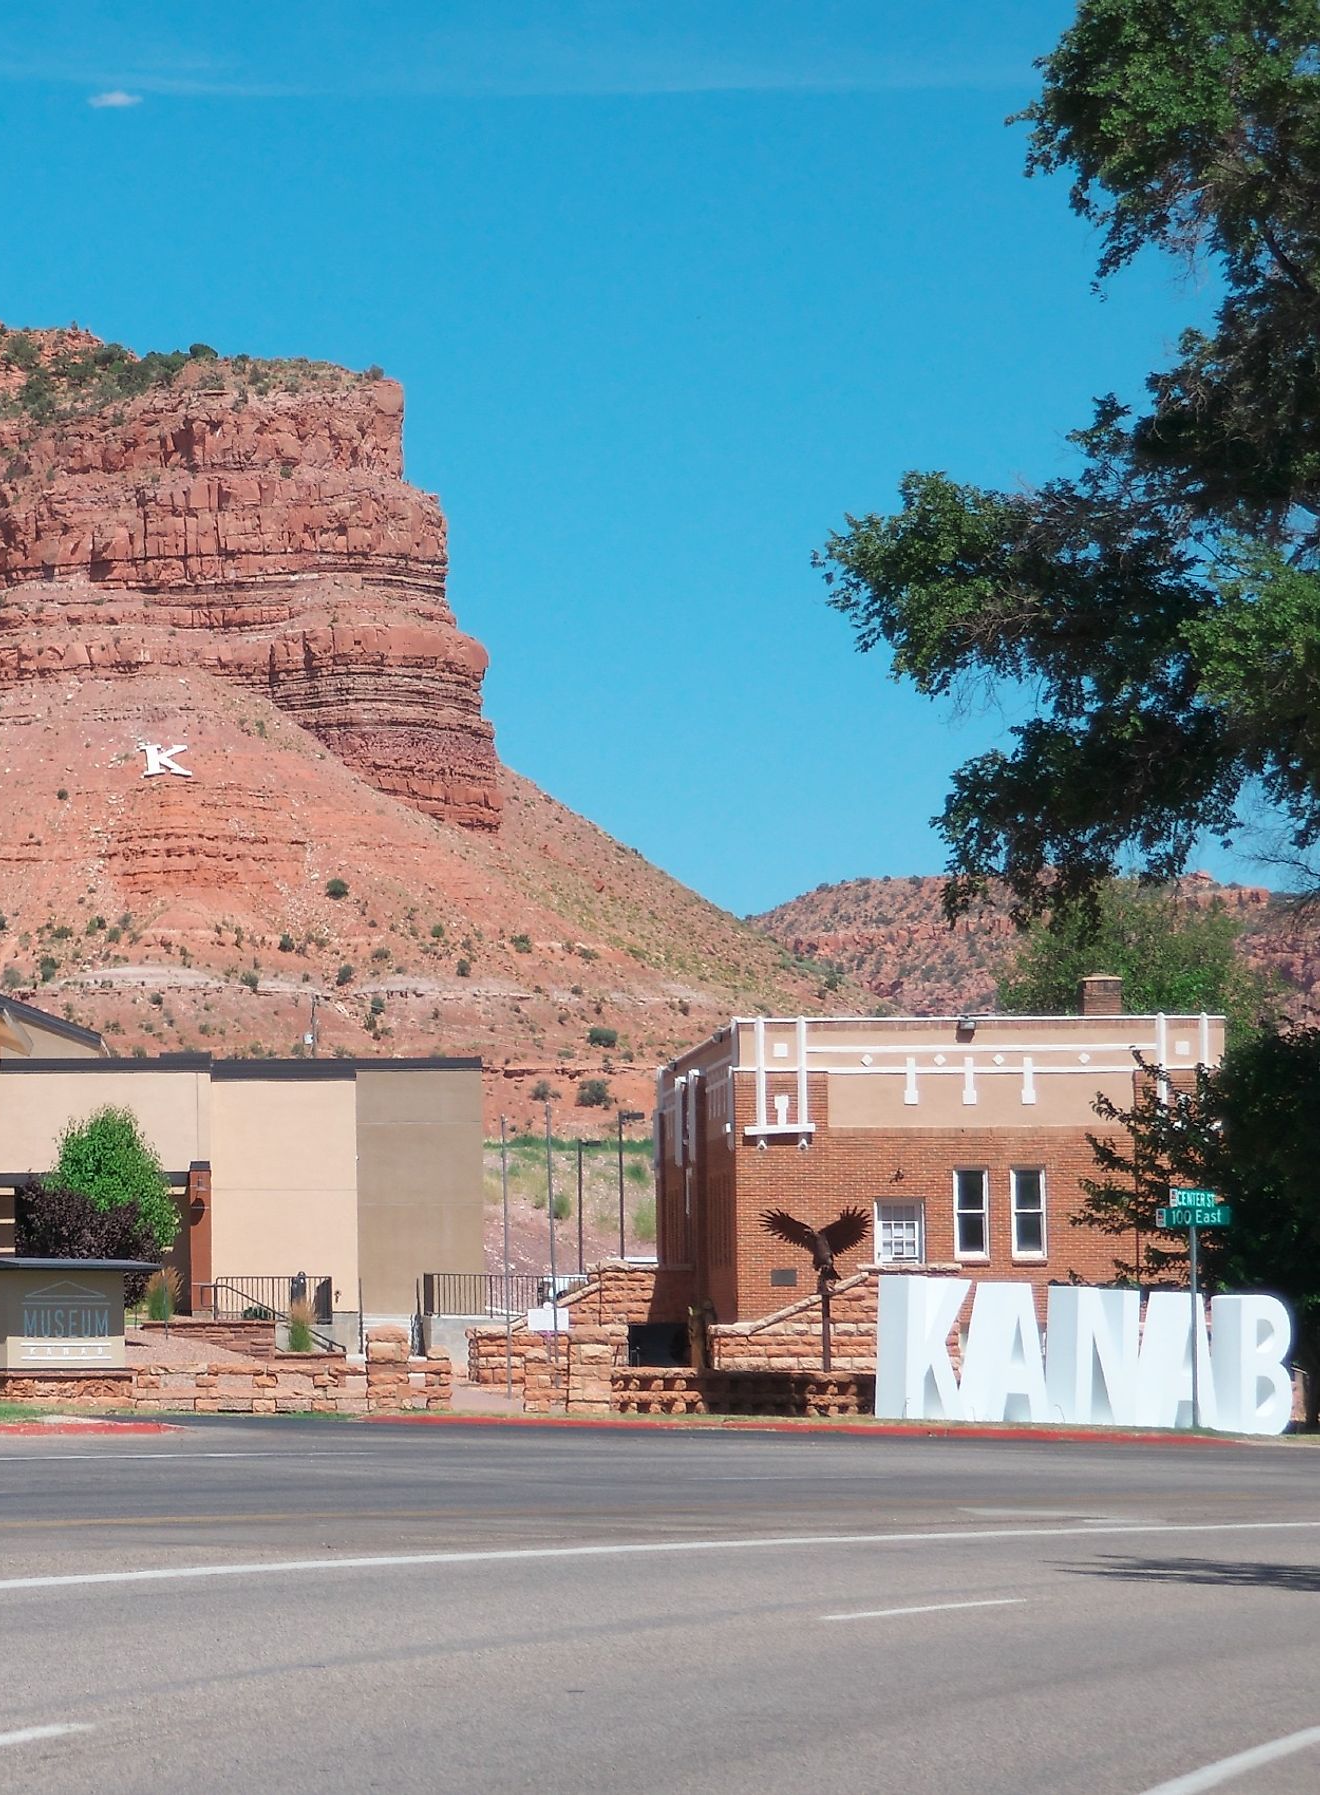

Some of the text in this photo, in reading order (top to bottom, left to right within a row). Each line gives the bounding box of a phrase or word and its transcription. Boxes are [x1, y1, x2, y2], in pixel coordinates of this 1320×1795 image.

[139, 744, 192, 778] K
[1176, 1191, 1215, 1207] CENTER ST
[1171, 1209, 1222, 1225] 100 East
[23, 1308, 110, 1338] MUSEUM
[875, 1275, 1293, 1436] KANAB
